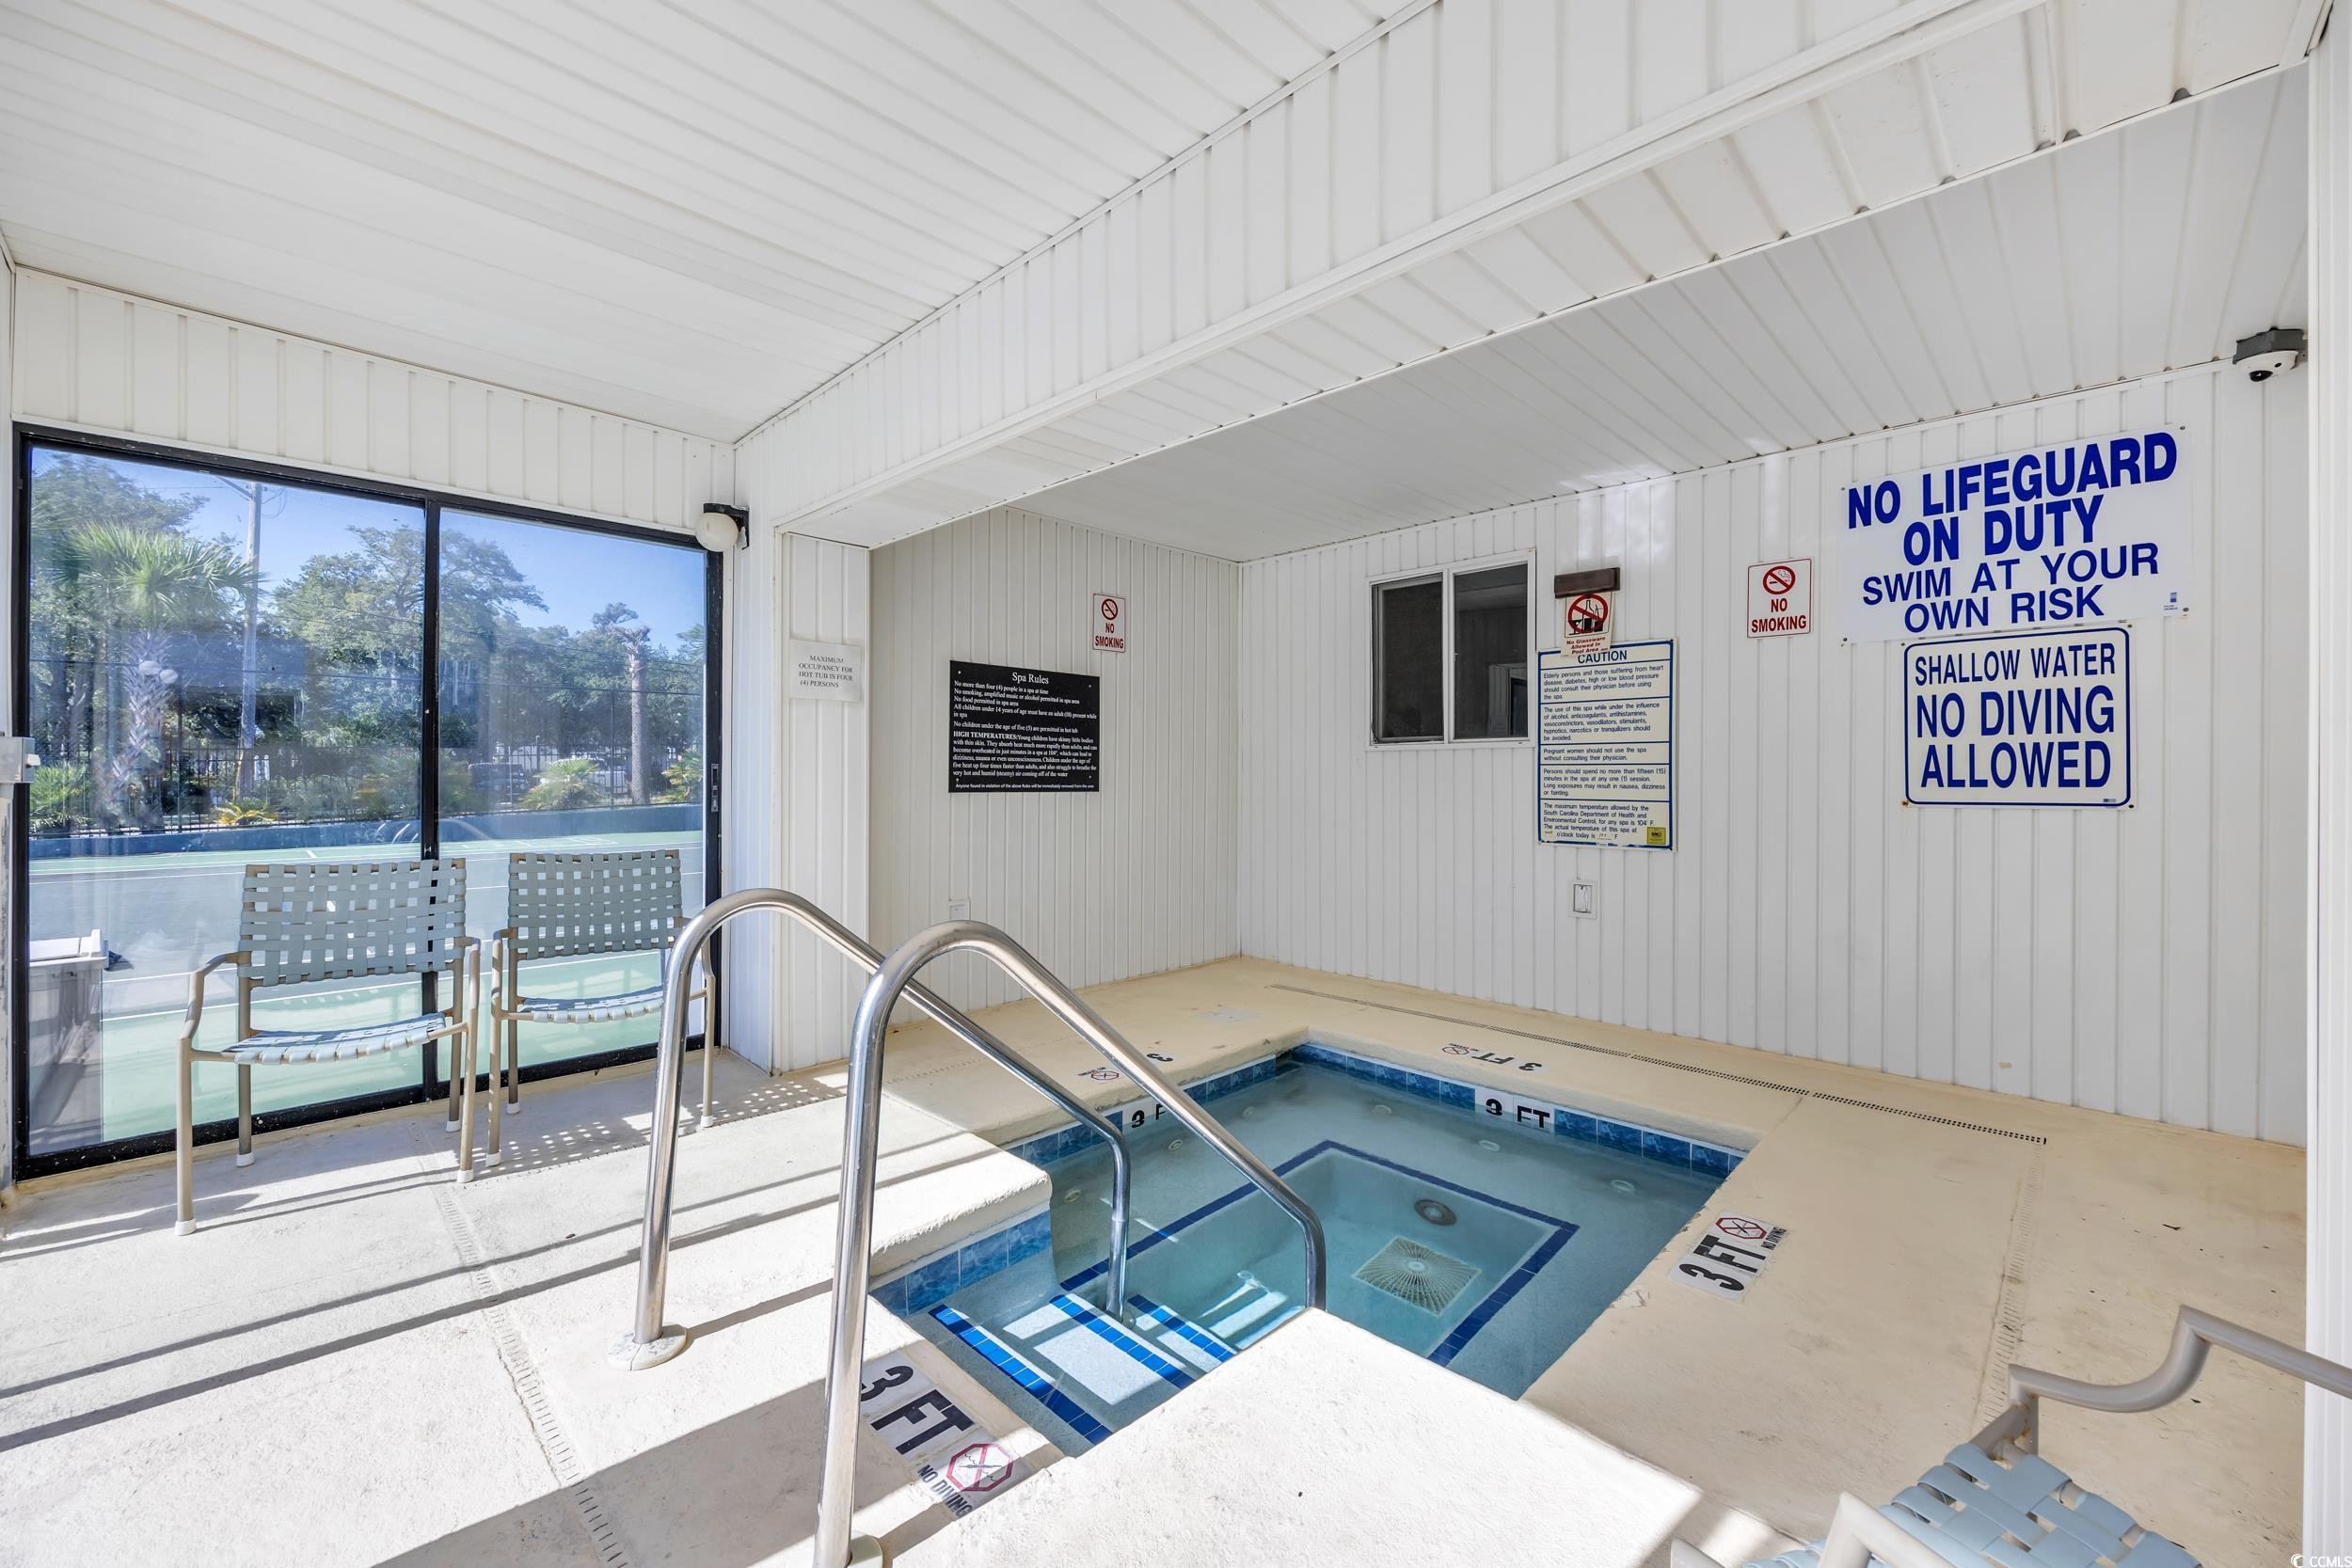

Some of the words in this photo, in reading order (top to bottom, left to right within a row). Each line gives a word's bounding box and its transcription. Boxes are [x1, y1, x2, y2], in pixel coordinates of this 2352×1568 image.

[1849, 480, 1900, 530] NO
[1923, 432, 2177, 516] LIFEGUARD
[1903, 516, 1959, 566] ON
[1984, 494, 2104, 556] DUTY
[1863, 567, 1951, 606] SWIM
[1971, 559, 2021, 594] AT
[2040, 542, 2158, 585] YOUR
[1771, 598, 1788, 612] NO
[1904, 596, 1989, 633] OWN
[2011, 584, 2105, 624] RISK
[1105, 623, 1114, 633] NO
[1752, 615, 1806, 633] SMOKING
[1095, 636, 1123, 648] SMOKING
[799, 663, 839, 672] OCCUPANCY
[1578, 650, 1628, 664] CAUTION
[1915, 649, 2020, 686] SHALLOW
[2031, 642, 2116, 678] WATER
[1012, 672, 1026, 684] Spa
[1029, 674, 1049, 684] Rules
[1594, 682, 1616, 690] physician
[1917, 692, 1965, 738] NO
[1980, 685, 2115, 736] DIVING
[1921, 740, 2111, 788] ALLOWED
[1147, 1053, 1173, 1062] 3
[1471, 1053, 1515, 1064] FT
[1132, 1110, 1145, 1128] 3
[1155, 1104, 1166, 1120] F
[1486, 1099, 1502, 1116] 3
[1518, 1105, 1550, 1129] FT
[1693, 1234, 1767, 1274] FT
[1678, 1263, 1744, 1291] 3
[861, 1366, 914, 1402] 3
[870, 1388, 975, 1455] FT
[917, 1464, 939, 1483] NO
[930, 1479, 973, 1518] DIVING
